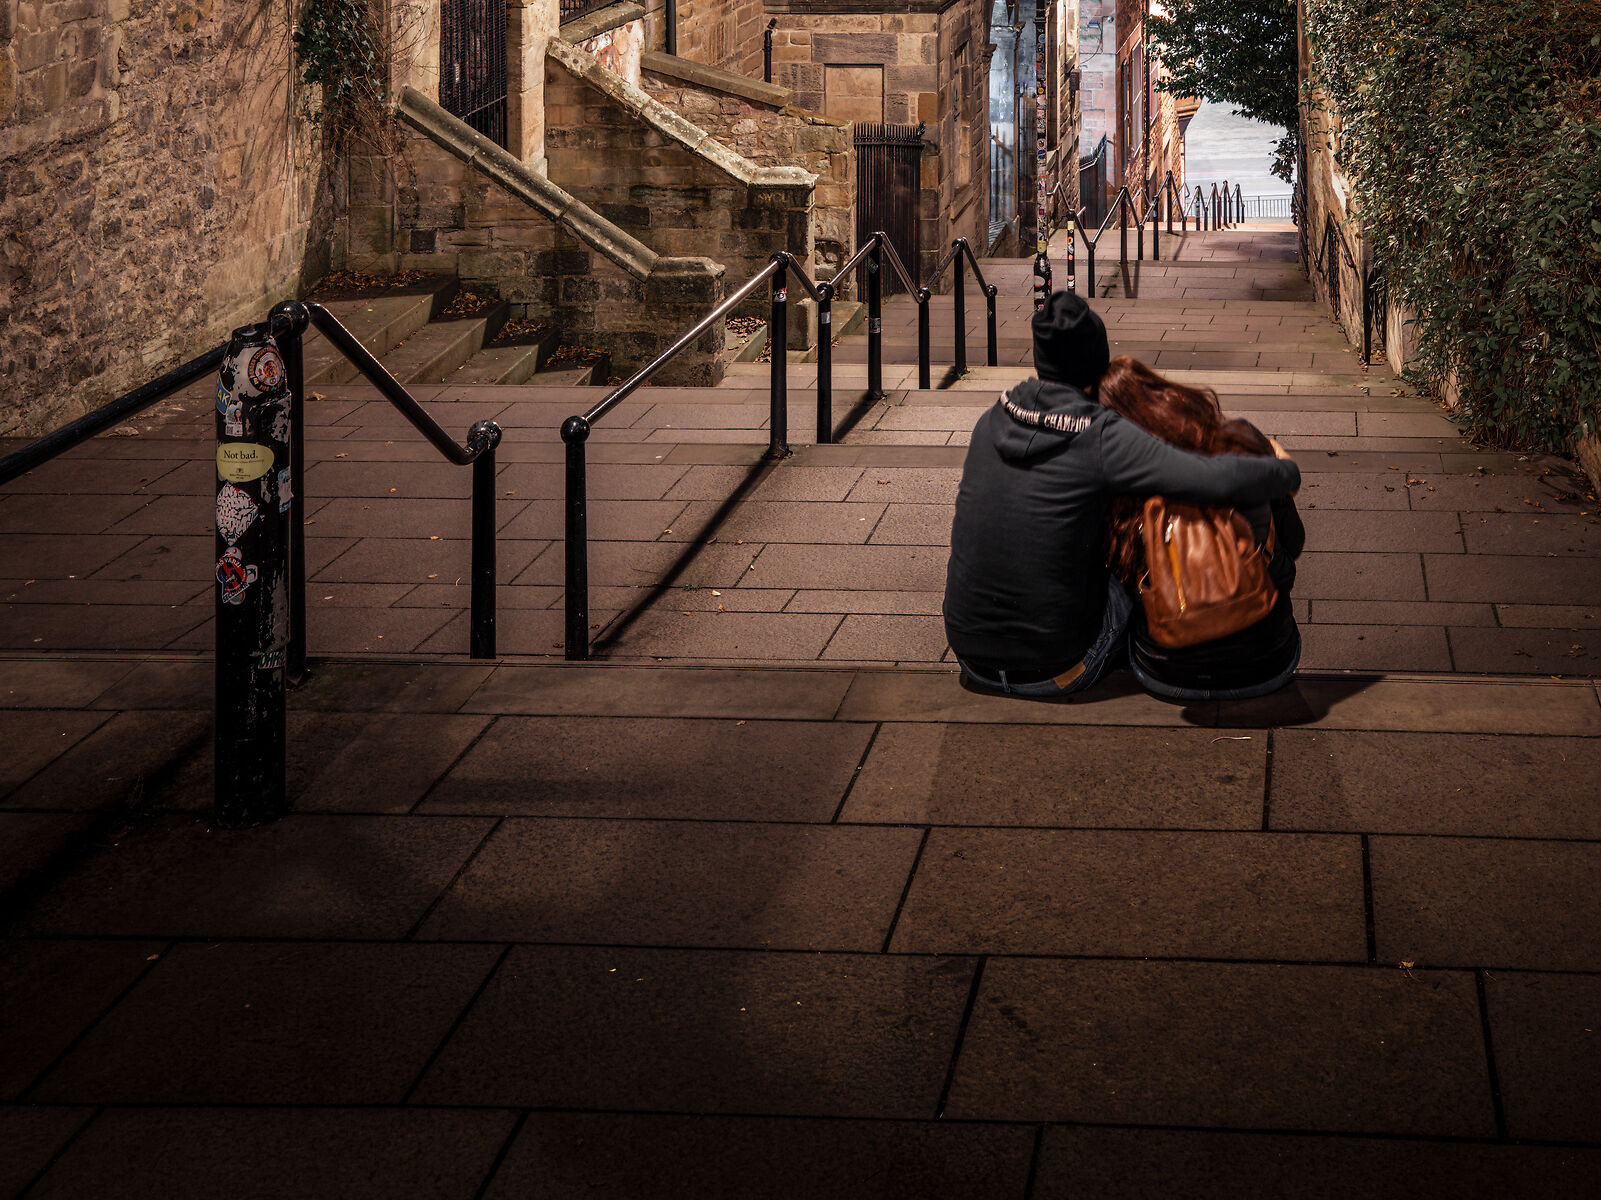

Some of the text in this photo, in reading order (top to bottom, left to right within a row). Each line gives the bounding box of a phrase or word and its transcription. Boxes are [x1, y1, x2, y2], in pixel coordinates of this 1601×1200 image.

[1043, 413, 1092, 433] CHAMPION
[223, 449, 258, 459] Not bad.
